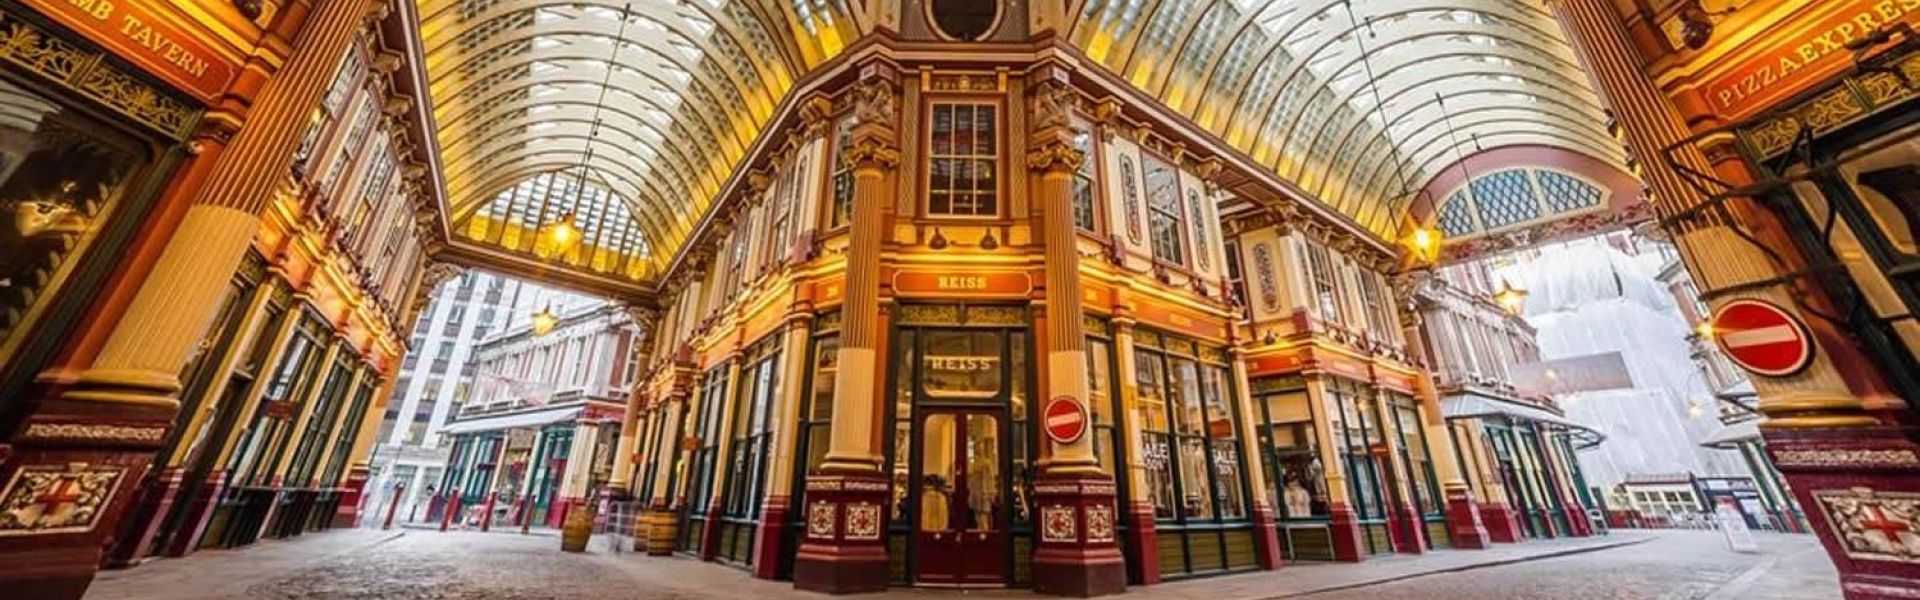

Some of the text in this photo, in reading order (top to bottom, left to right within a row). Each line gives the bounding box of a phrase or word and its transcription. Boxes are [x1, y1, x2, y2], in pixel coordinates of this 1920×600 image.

[121, 14, 209, 77] TAVERN
[938, 276, 987, 289] REISS
[932, 358, 990, 370] REISS
